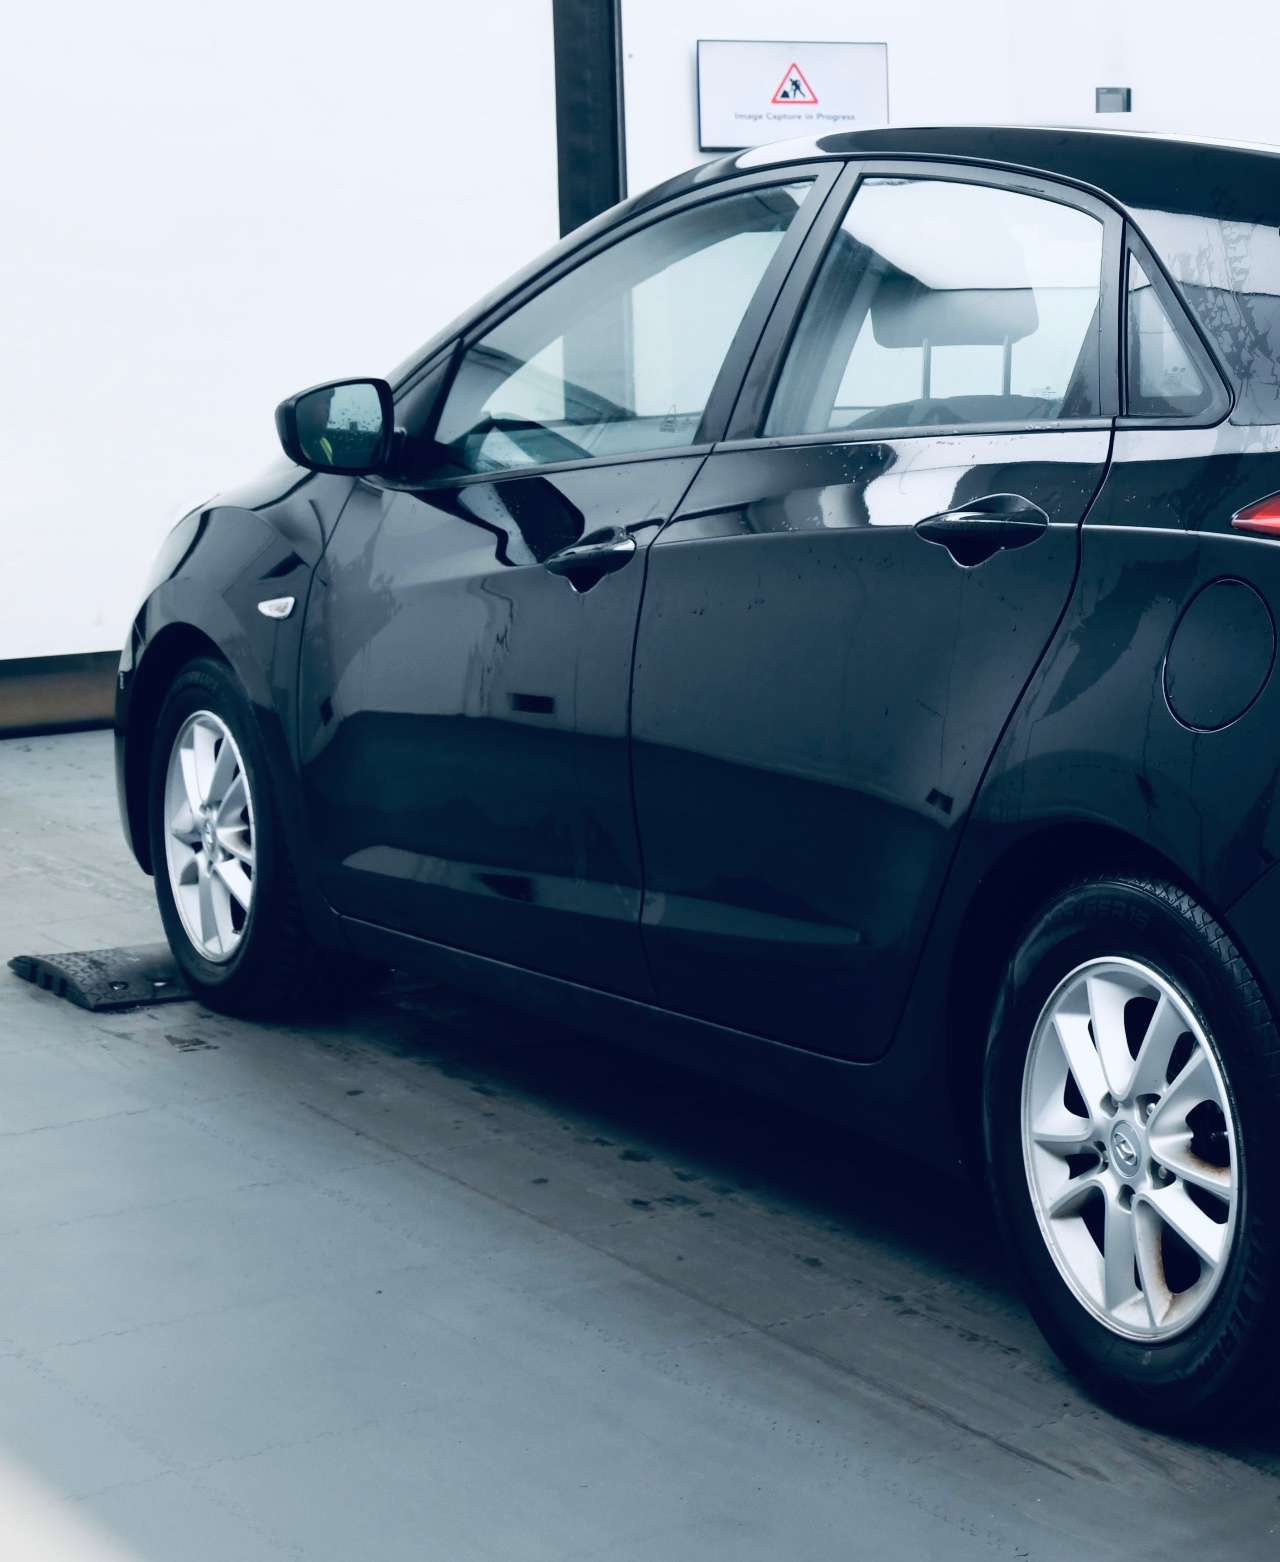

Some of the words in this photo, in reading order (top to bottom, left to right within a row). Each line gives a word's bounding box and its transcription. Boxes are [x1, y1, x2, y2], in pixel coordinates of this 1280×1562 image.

[734, 112, 763, 121] Image
[766, 112, 803, 122] Capture
[805, 112, 814, 121] in
[816, 112, 856, 121] Progress
